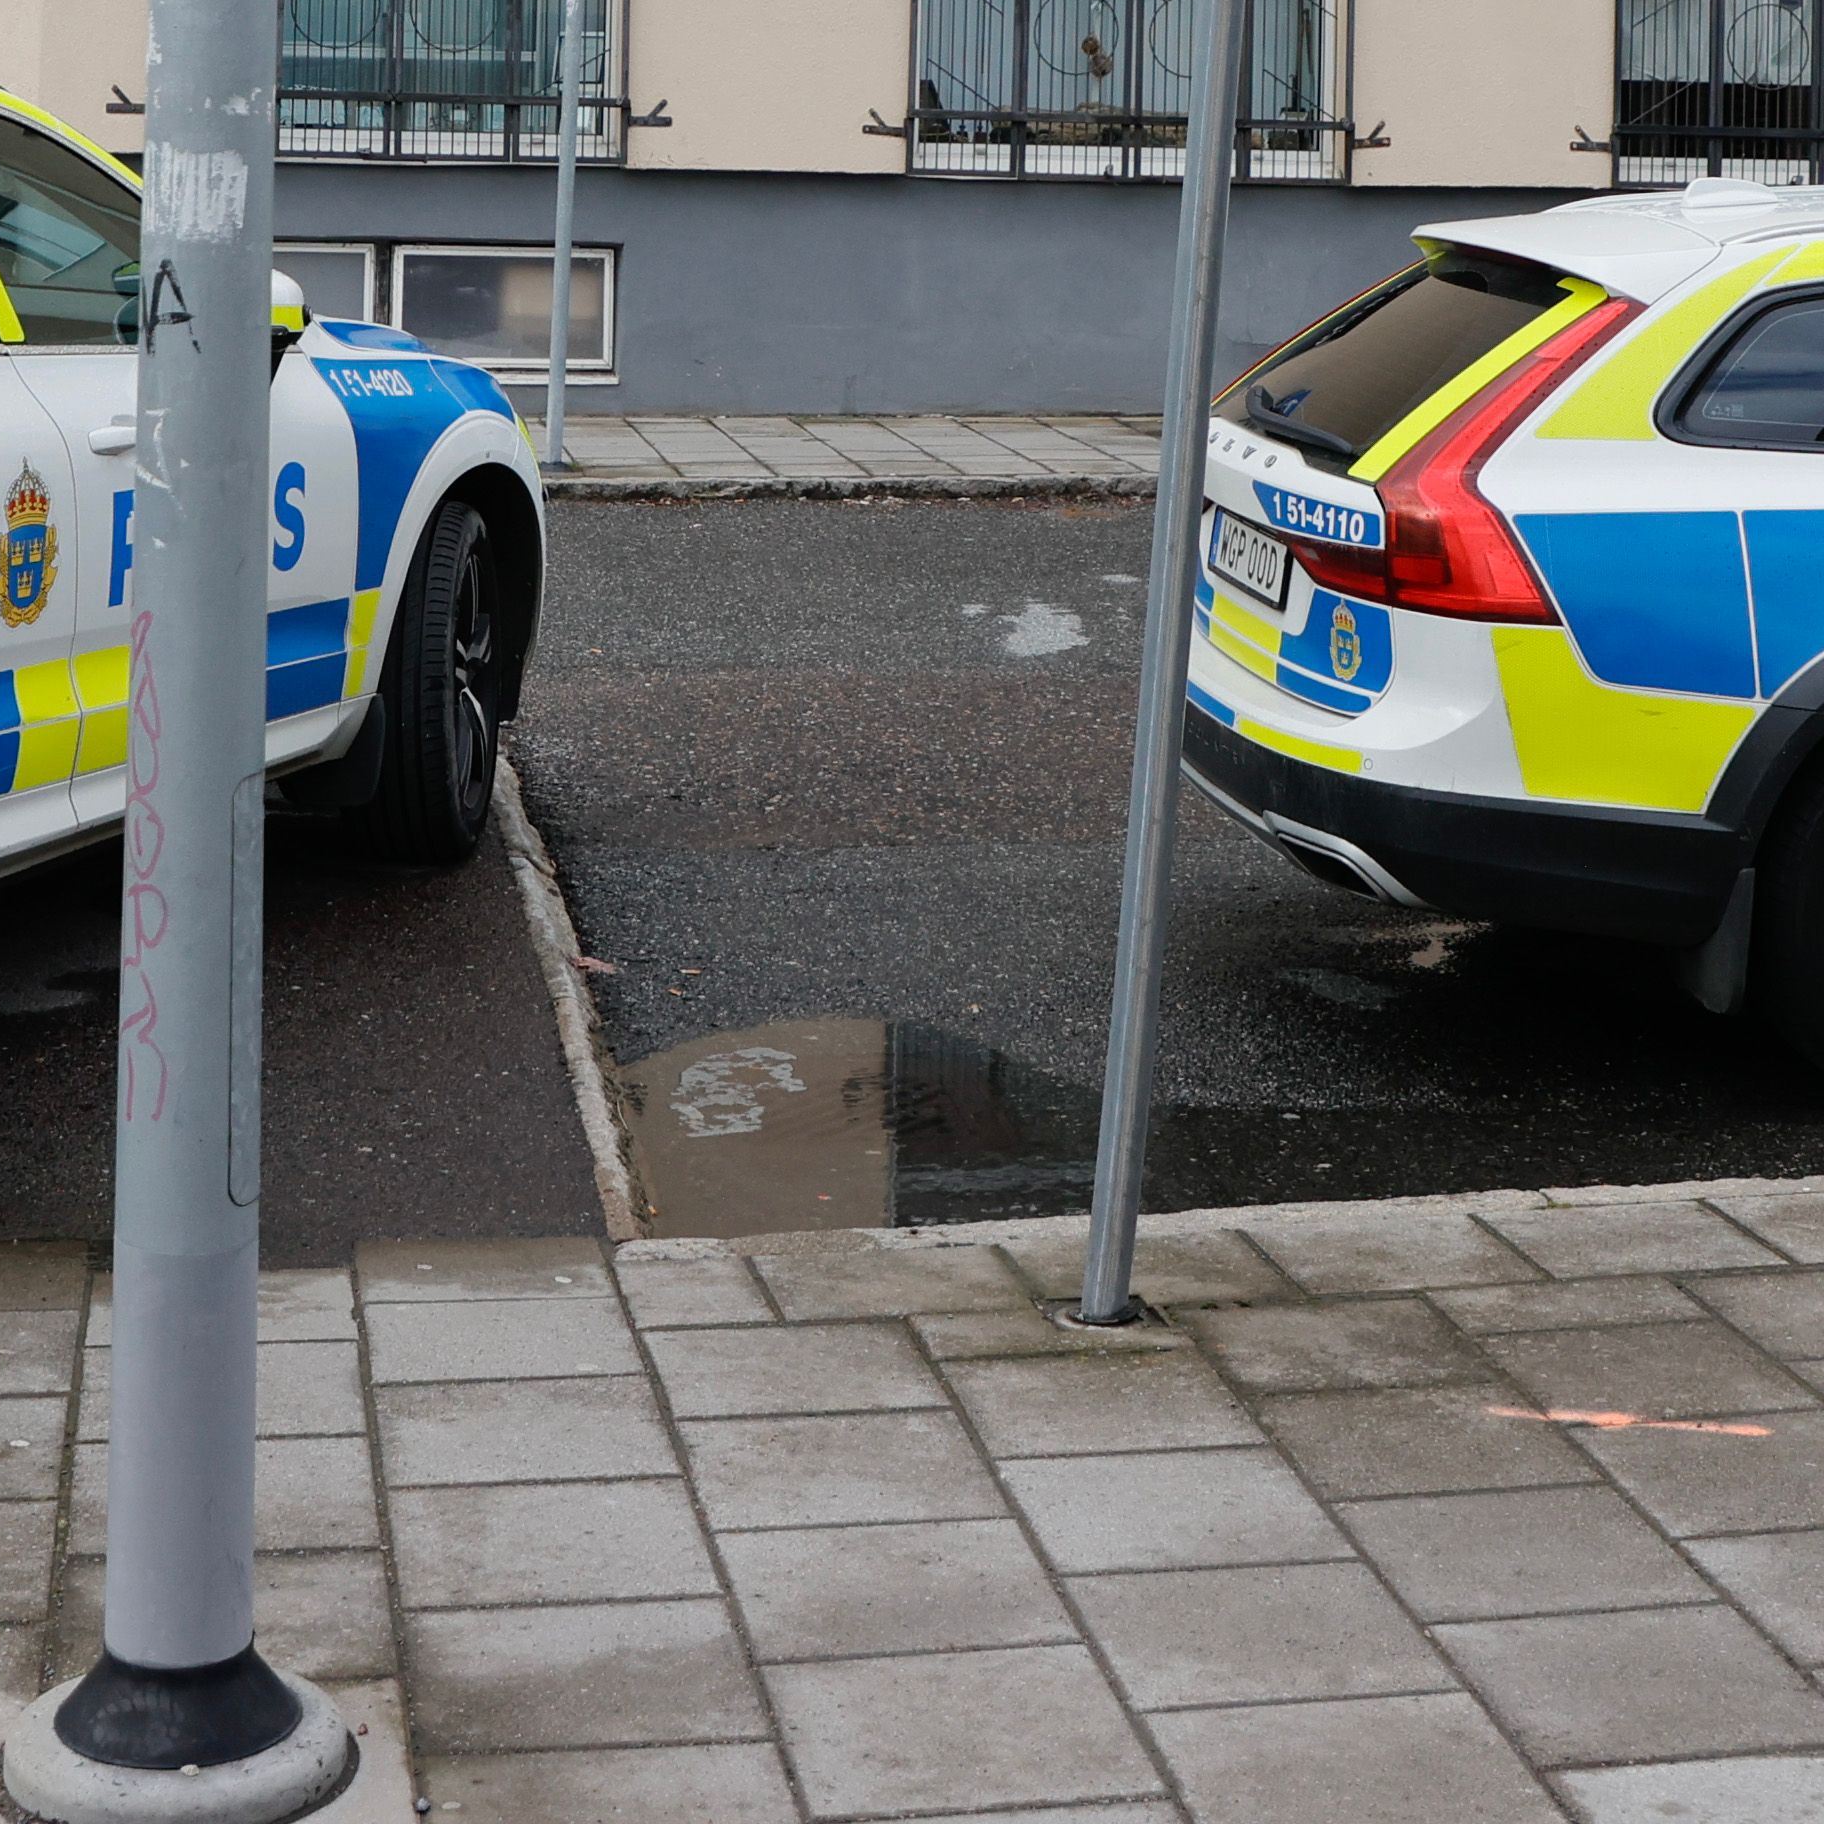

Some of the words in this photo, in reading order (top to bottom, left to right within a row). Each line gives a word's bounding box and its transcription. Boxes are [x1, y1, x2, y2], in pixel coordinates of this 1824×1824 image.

[1209, 431, 1277, 468] OLVO
[1273, 491, 1282, 520] 1
[1287, 495, 1365, 543] 51-4110
[1220, 519, 1247, 572] WGP
